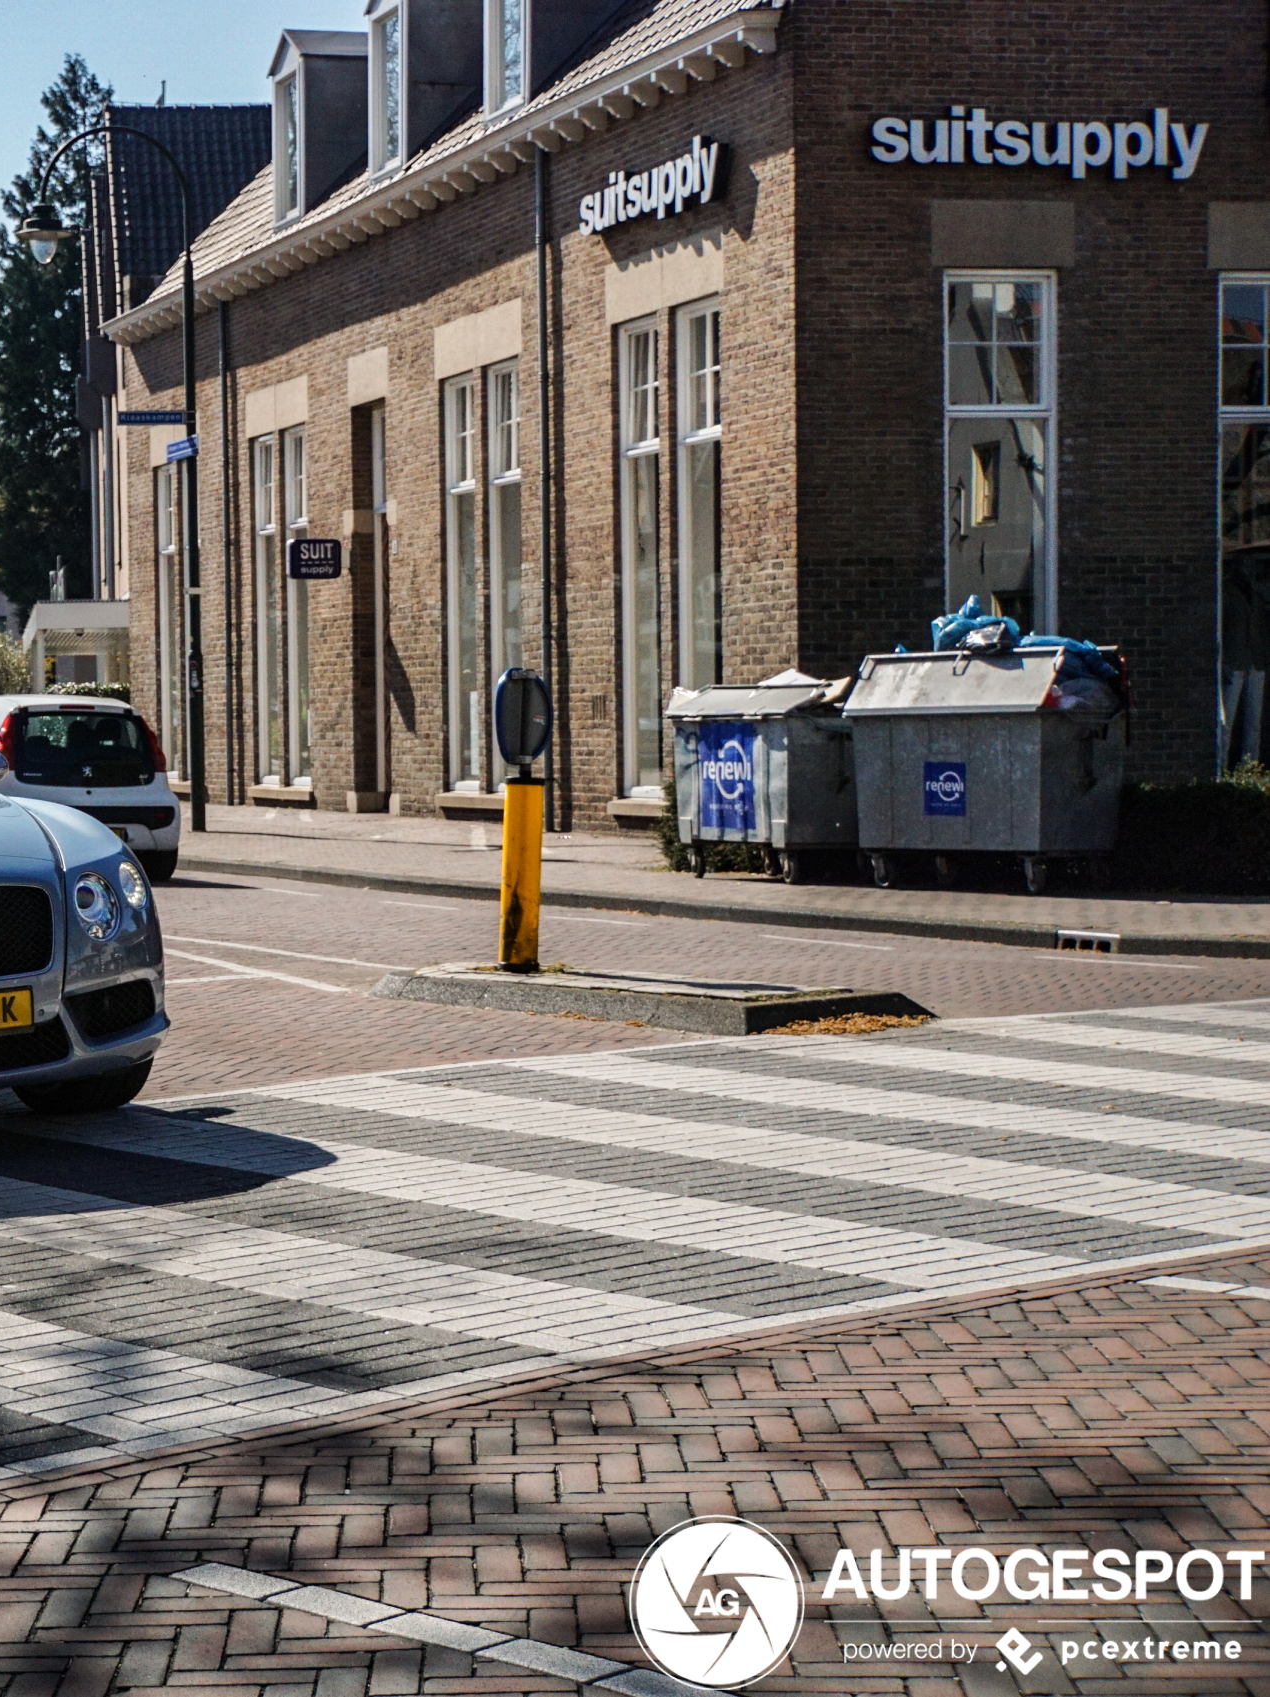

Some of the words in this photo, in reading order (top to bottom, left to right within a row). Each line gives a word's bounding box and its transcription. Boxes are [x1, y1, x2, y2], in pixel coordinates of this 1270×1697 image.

[871, 105, 1210, 179] suitsupply
[579, 134, 719, 236] suitsupply
[300, 543, 334, 560] SUIT
[300, 566, 334, 575] supply
[702, 760, 752, 781] renewi
[925, 781, 964, 792] renewi
